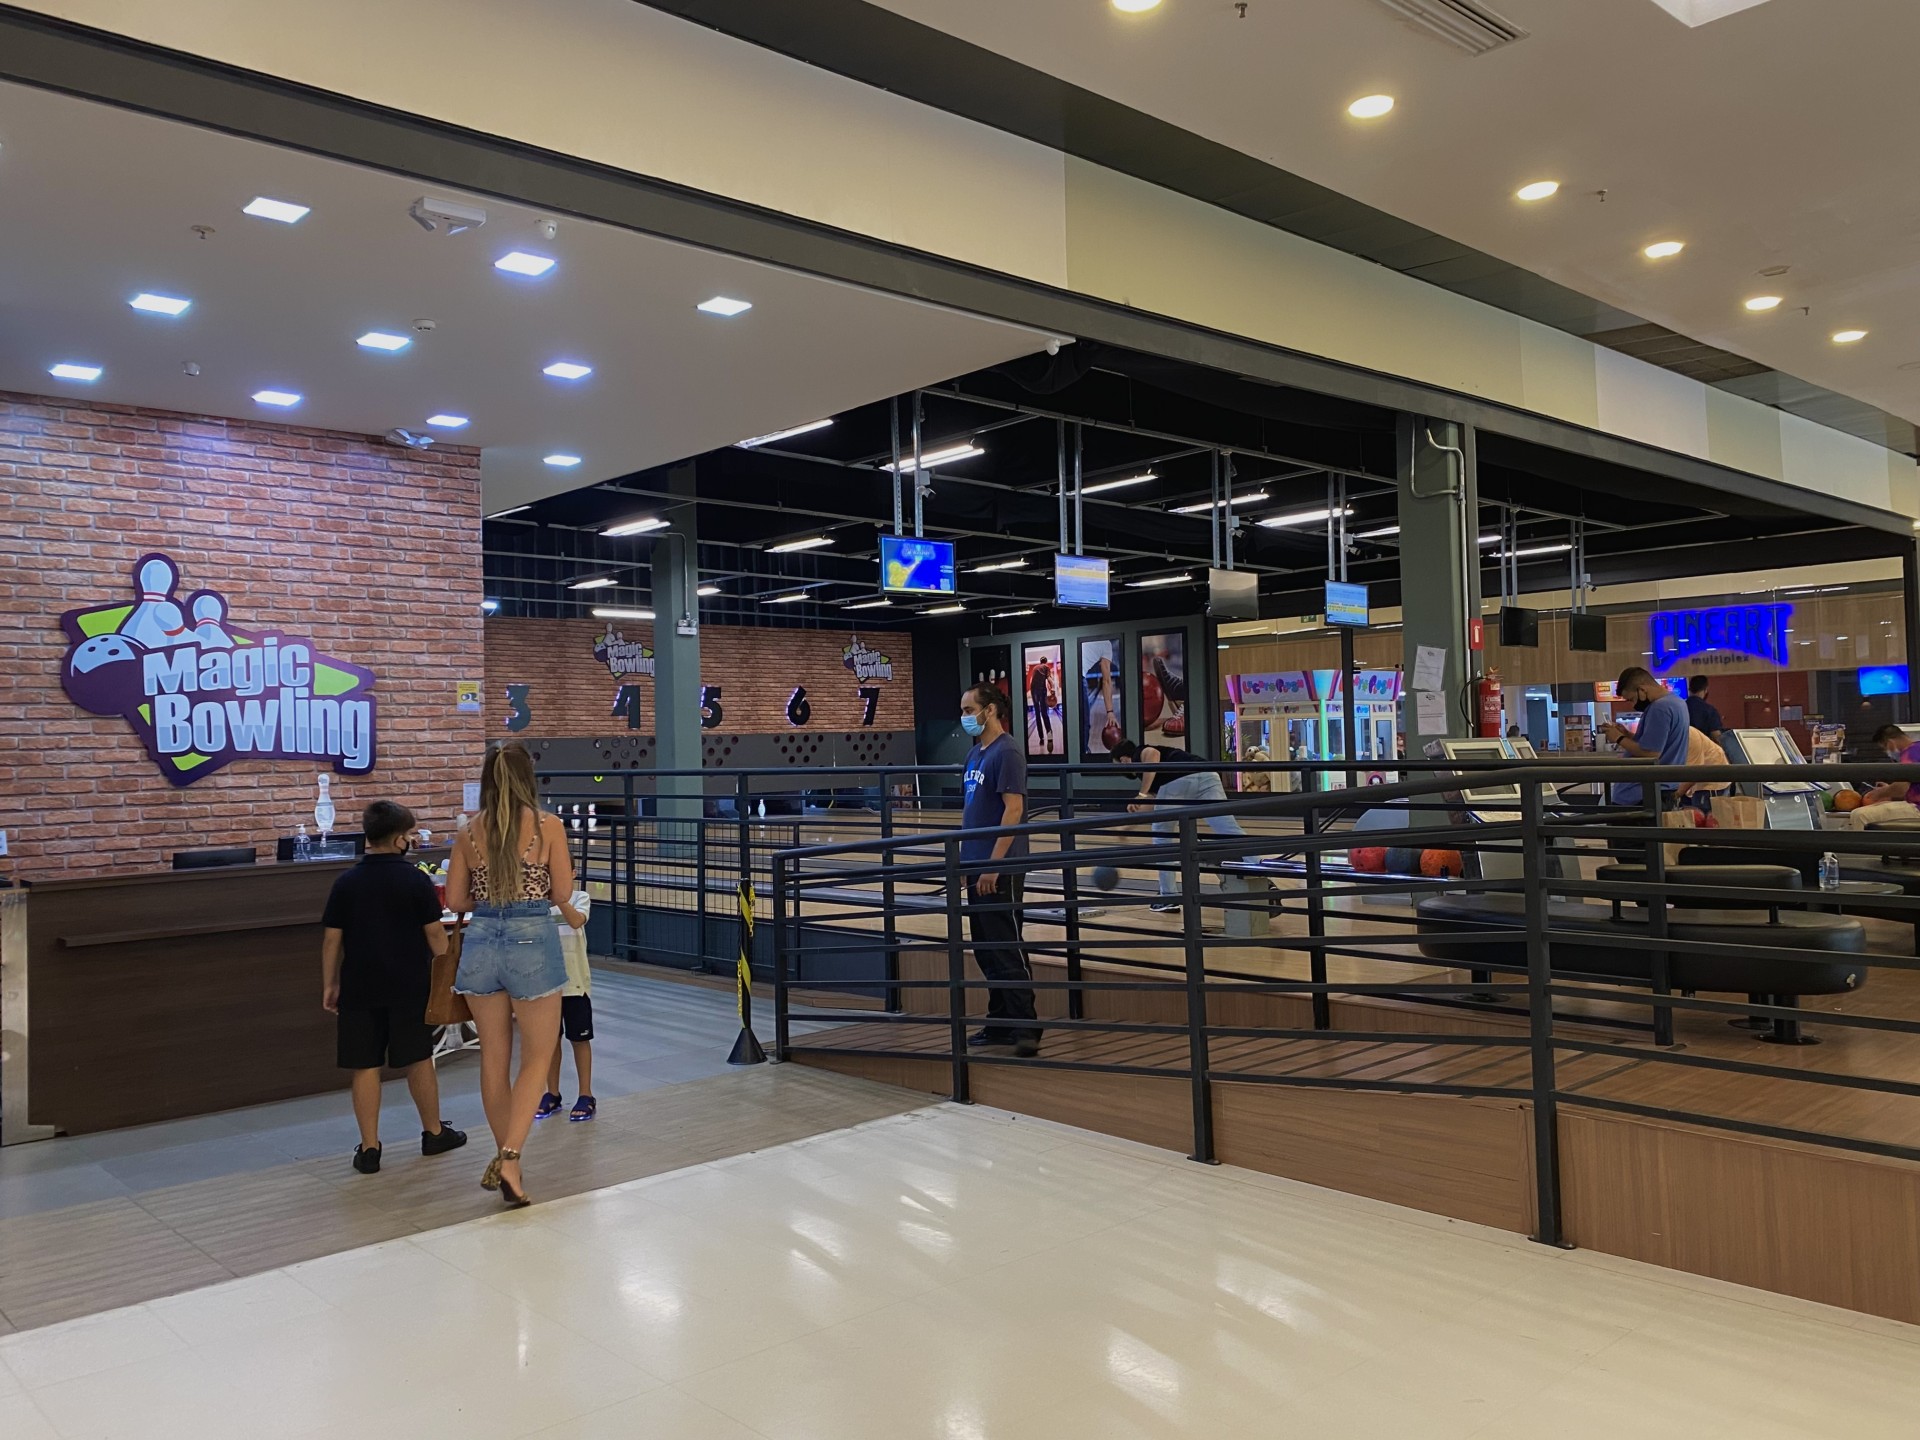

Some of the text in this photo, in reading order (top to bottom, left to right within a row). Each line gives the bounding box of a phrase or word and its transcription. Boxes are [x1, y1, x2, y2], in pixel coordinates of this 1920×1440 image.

[607, 642, 643, 659] Magic
[853, 650, 881, 666] Magic
[1650, 606, 1787, 668] CINEART
[143, 637, 310, 696] Magic
[610, 655, 655, 677] Bowling
[856, 661, 893, 681] Bowling
[1691, 654, 1750, 666] multiplex
[505, 683, 532, 732] 3
[611, 684, 641, 729] 4
[700, 685, 723, 729] 5
[786, 685, 811, 727] 6
[858, 686, 881, 726] 7
[154, 687, 370, 769] Bowling
